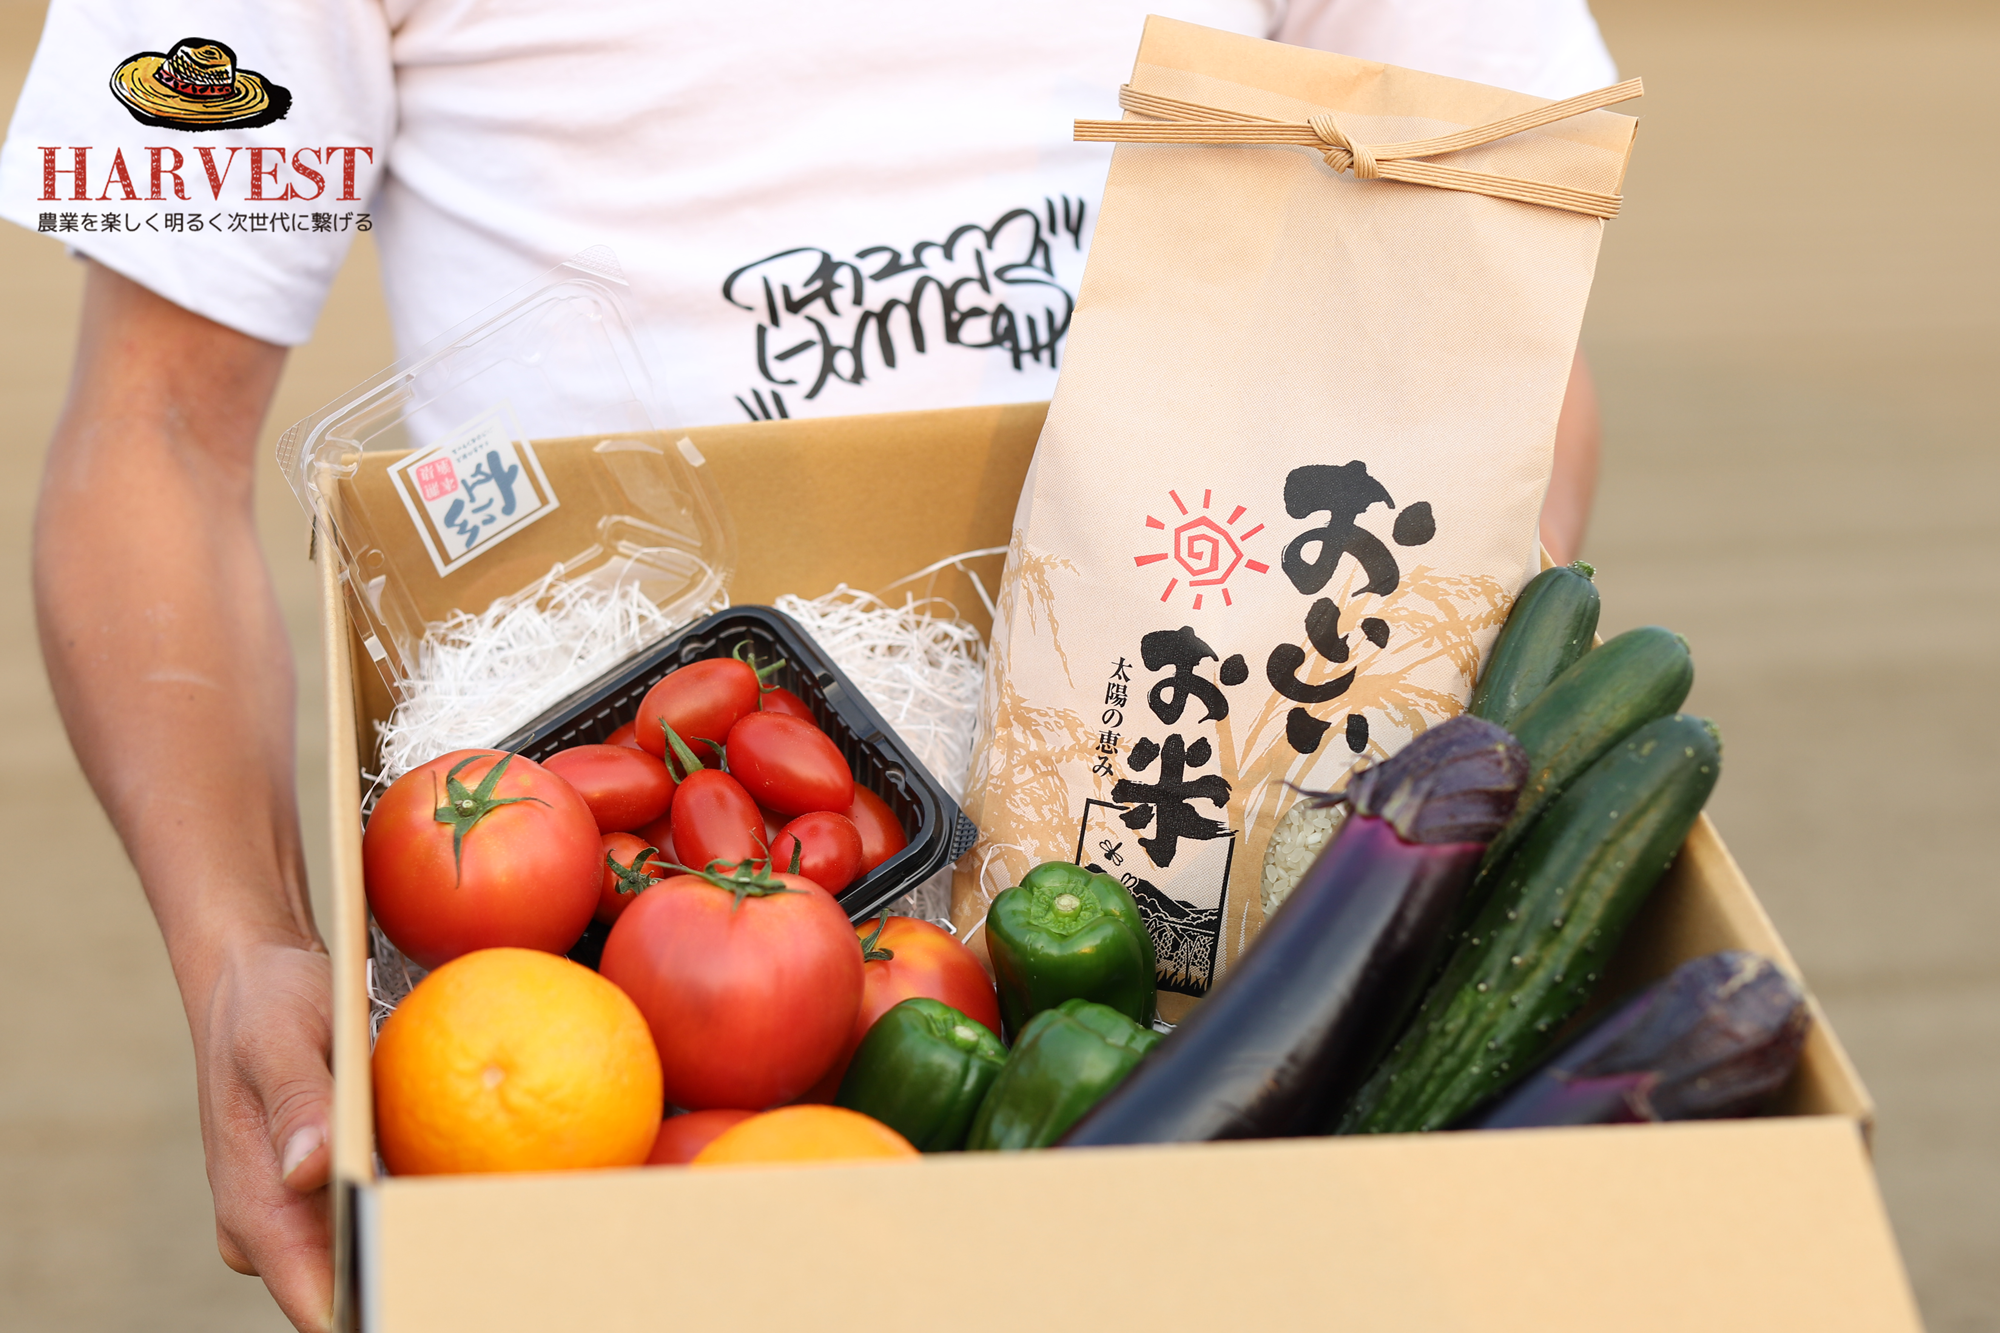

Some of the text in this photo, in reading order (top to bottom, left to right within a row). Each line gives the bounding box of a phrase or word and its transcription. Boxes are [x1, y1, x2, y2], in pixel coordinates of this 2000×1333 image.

[1092, 656, 1133, 778] 太陽の恵み
[1266, 459, 1437, 755] おいしい
[1110, 625, 1249, 868] お米
